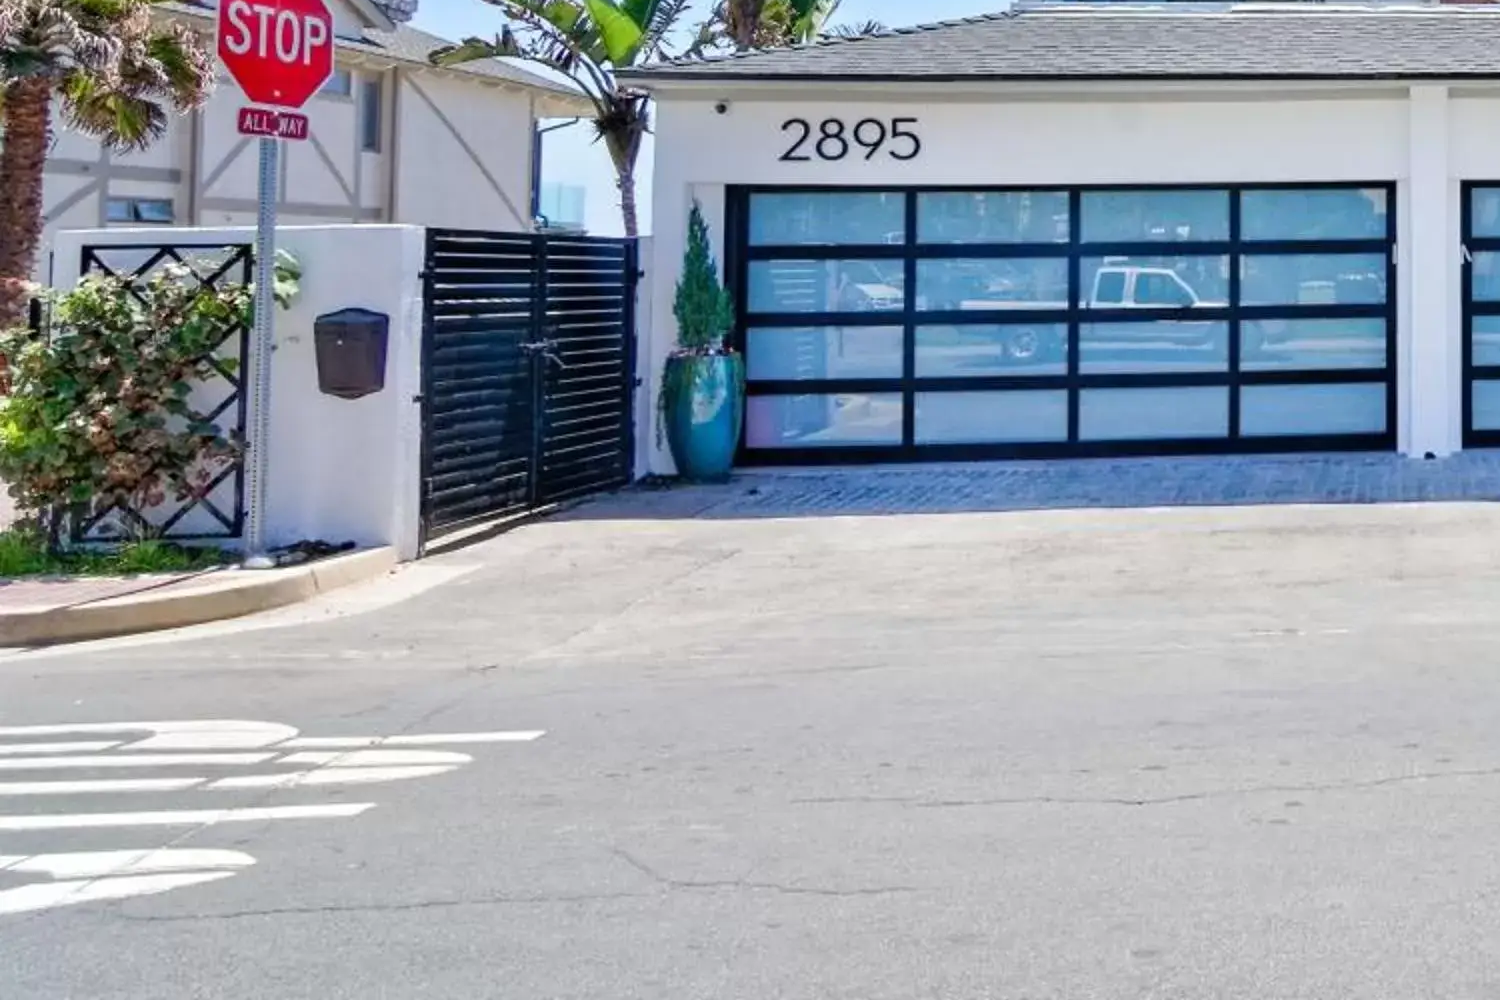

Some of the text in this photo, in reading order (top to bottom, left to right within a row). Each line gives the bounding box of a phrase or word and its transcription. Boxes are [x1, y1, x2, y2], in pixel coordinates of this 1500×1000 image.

[225, 0, 326, 66] STOP
[243, 114, 305, 136] ALL WAY
[778, 117, 921, 162] 2895
